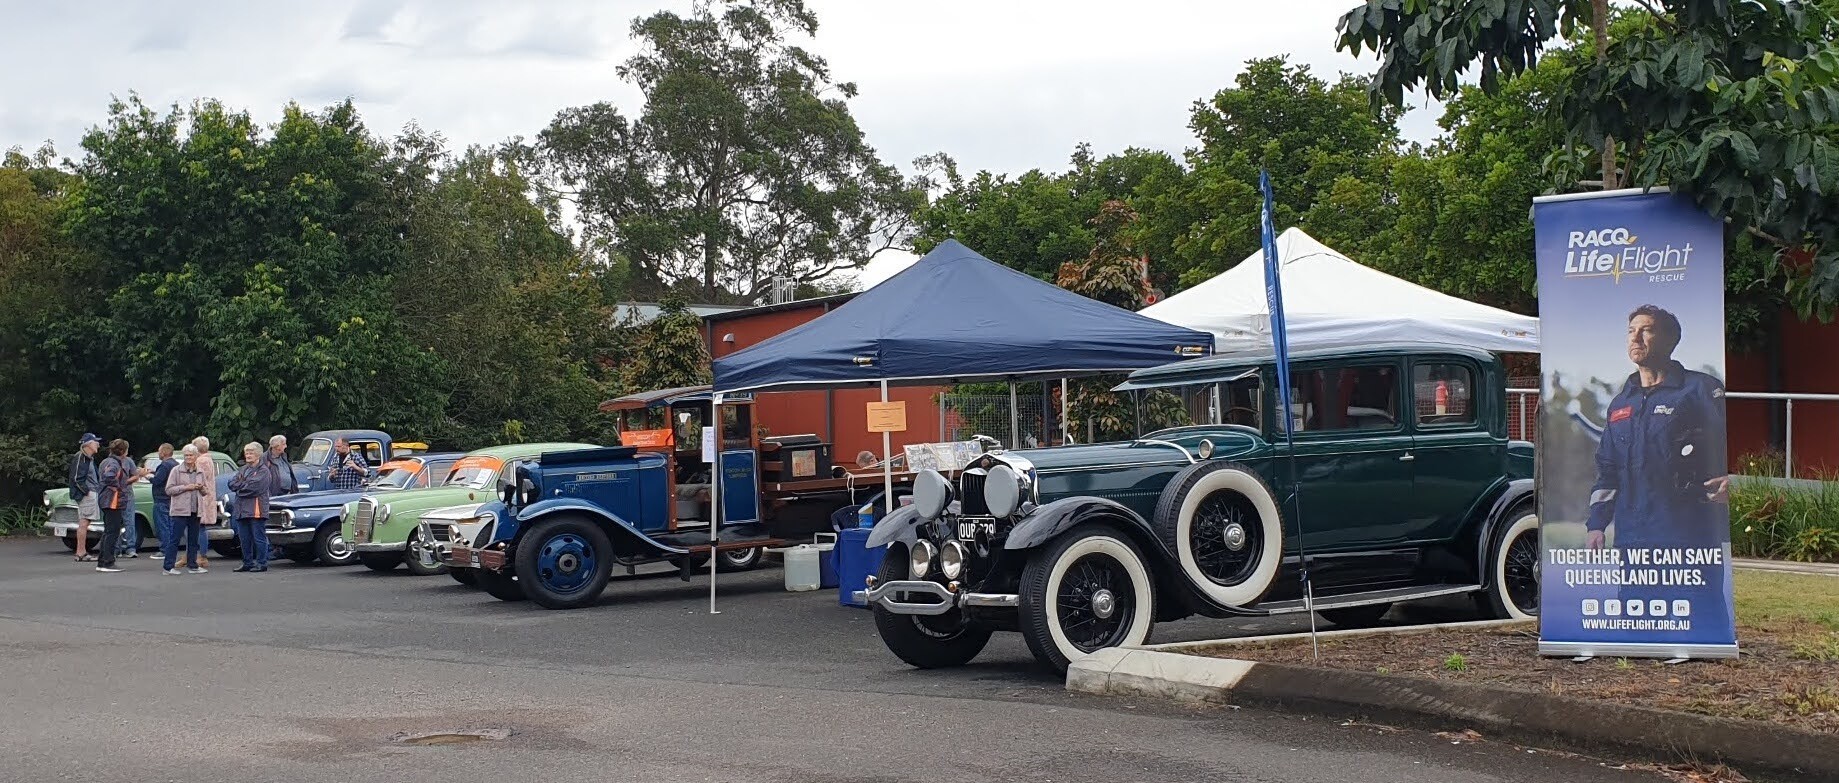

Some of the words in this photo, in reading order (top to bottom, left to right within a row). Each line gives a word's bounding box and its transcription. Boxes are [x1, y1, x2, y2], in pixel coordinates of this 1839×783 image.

[1568, 228, 1631, 248] RACQ
[1649, 273, 1685, 283] RESCUE
[1549, 548, 1625, 567] TOGETHER,
[1627, 548, 1650, 565] WE
[1653, 548, 1682, 565] CAN
[1685, 548, 1722, 565] SAVE
[1565, 569, 1659, 588] QUEENSLAND
[1662, 569, 1706, 586] LIVES.
[1582, 618, 1690, 631] WWW.LIFEFLIGHT.ORG.AU
